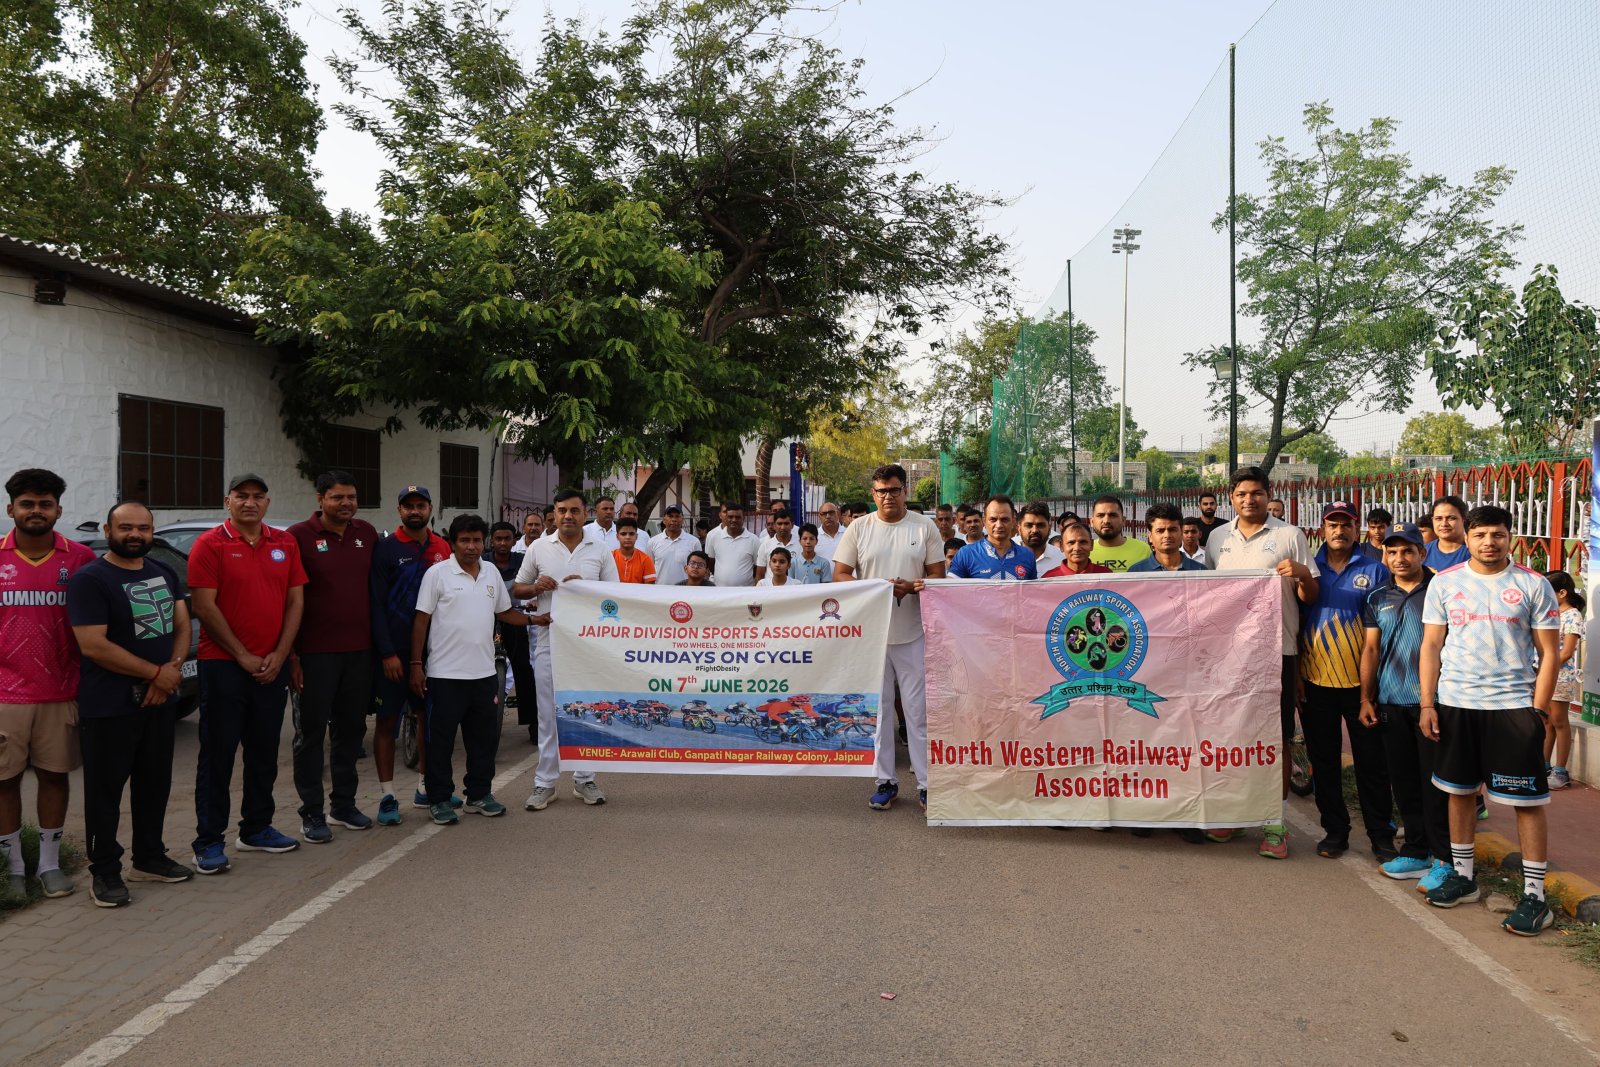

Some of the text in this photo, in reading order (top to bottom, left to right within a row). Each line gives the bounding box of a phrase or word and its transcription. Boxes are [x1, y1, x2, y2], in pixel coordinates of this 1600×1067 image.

[1096, 560, 1127, 568] HRX
[578, 625, 862, 639] JAIPUR DIVISION SPORTS ASSOCIATION
[1050, 594, 1144, 672] NORTH WESTERN RAILWAY SPORTS ASSOCIATION
[624, 650, 812, 664] SUNDAYS ON CYCLE
[648, 675, 789, 693] ON 7th JUNE 2026
[1060, 682, 1137, 695] उत्तर पश्चिम रेलवे
[579, 748, 864, 763] VENUE:- Arawali Club, Ganpati Nagar Railway Colony, Jaipur
[930, 739, 1276, 772] North Western Railway Sports
[1034, 771, 1168, 798] Association
